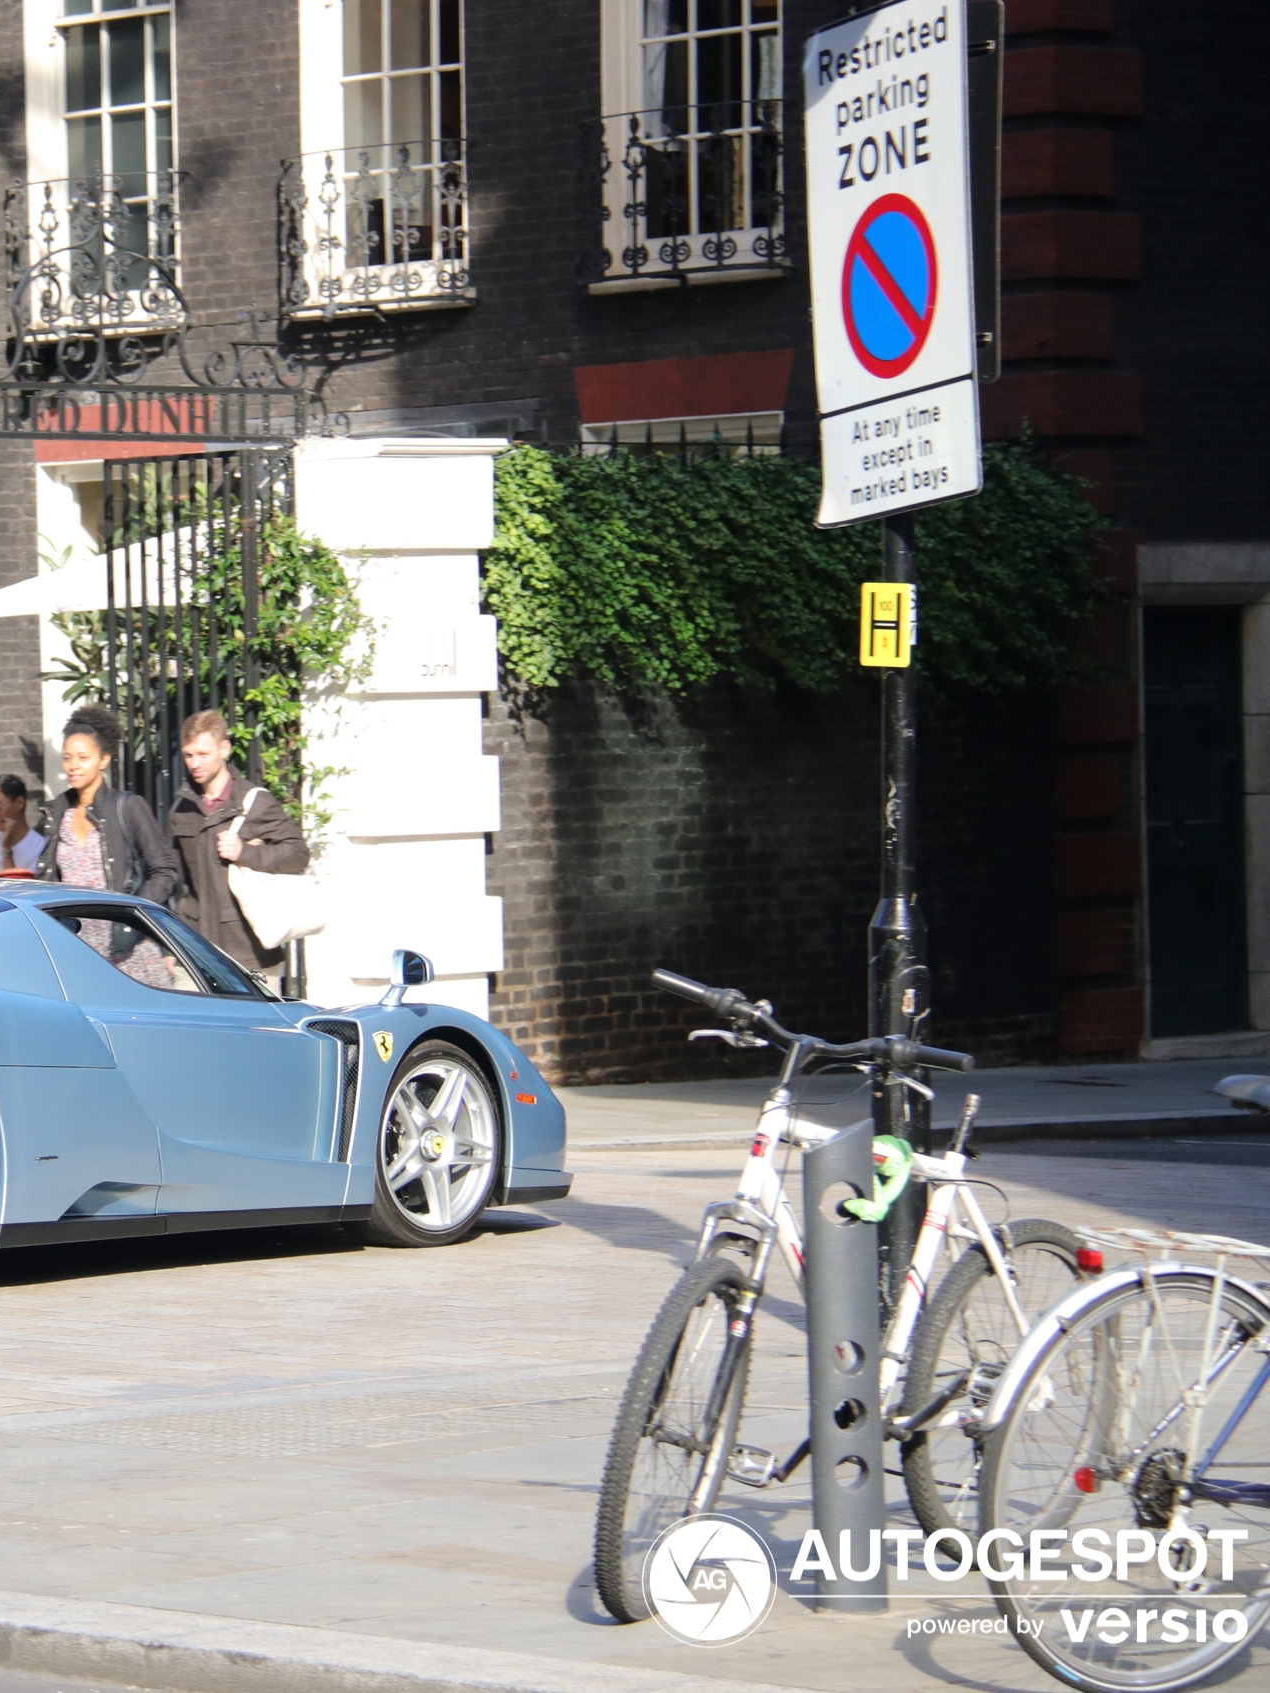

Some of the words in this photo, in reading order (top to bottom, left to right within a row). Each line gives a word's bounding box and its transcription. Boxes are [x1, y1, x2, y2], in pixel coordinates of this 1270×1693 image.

[818, 5, 948, 86] Restricted
[837, 72, 930, 136] parking
[838, 117, 931, 190] ZONE
[852, 420, 870, 444] At
[874, 416, 901, 438] any
[906, 405, 941, 430] time
[862, 438, 914, 471] except
[917, 435, 933, 457] in
[850, 470, 907, 505] marked
[912, 466, 949, 490] bays
